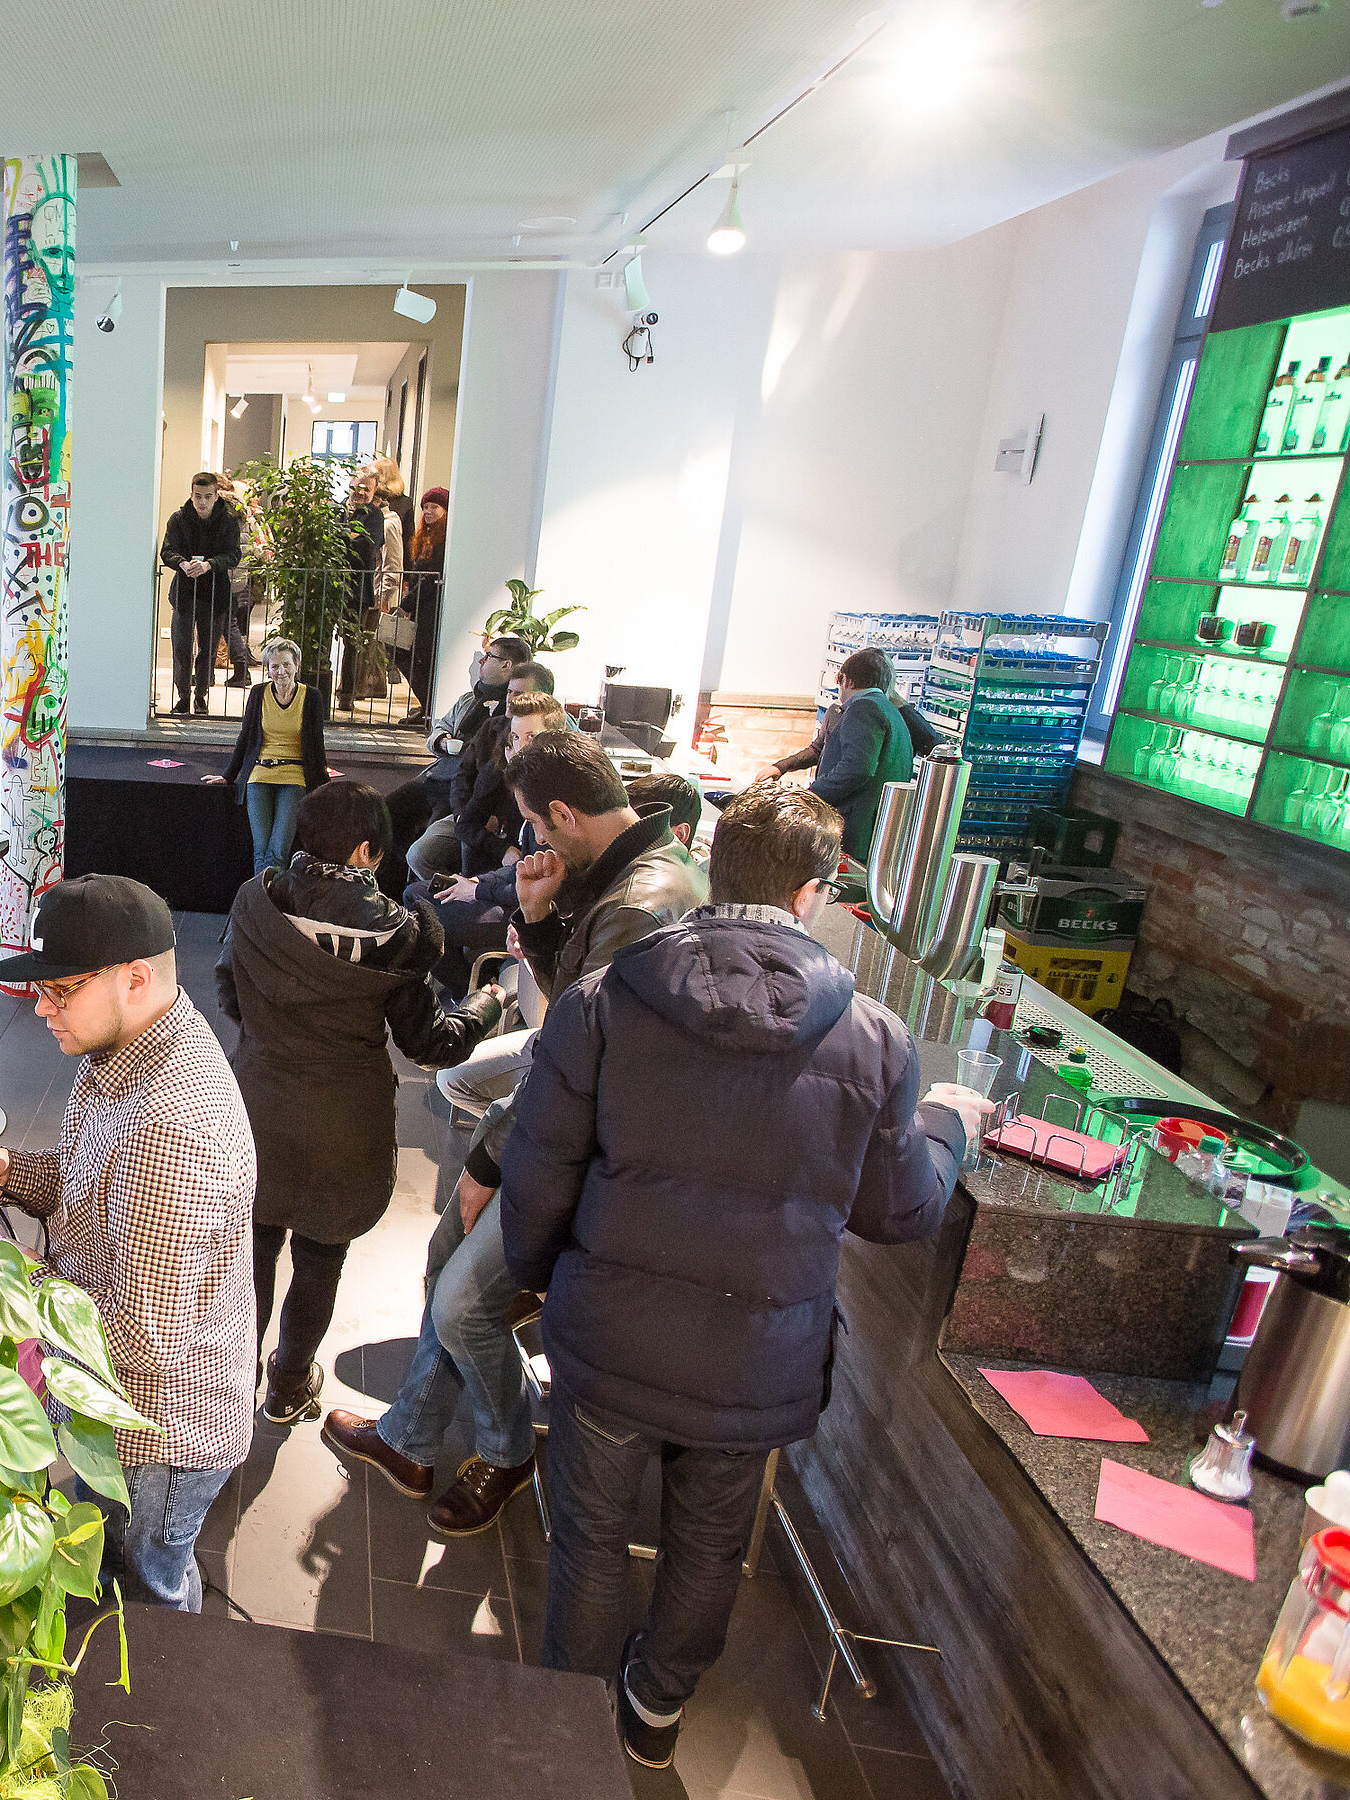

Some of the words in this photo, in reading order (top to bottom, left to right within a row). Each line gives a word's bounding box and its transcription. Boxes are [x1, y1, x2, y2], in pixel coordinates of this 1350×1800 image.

[1234, 250, 1270, 280] Becks
[20, 542, 66, 568] THE
[1058, 918, 1118, 931] BECK'S
